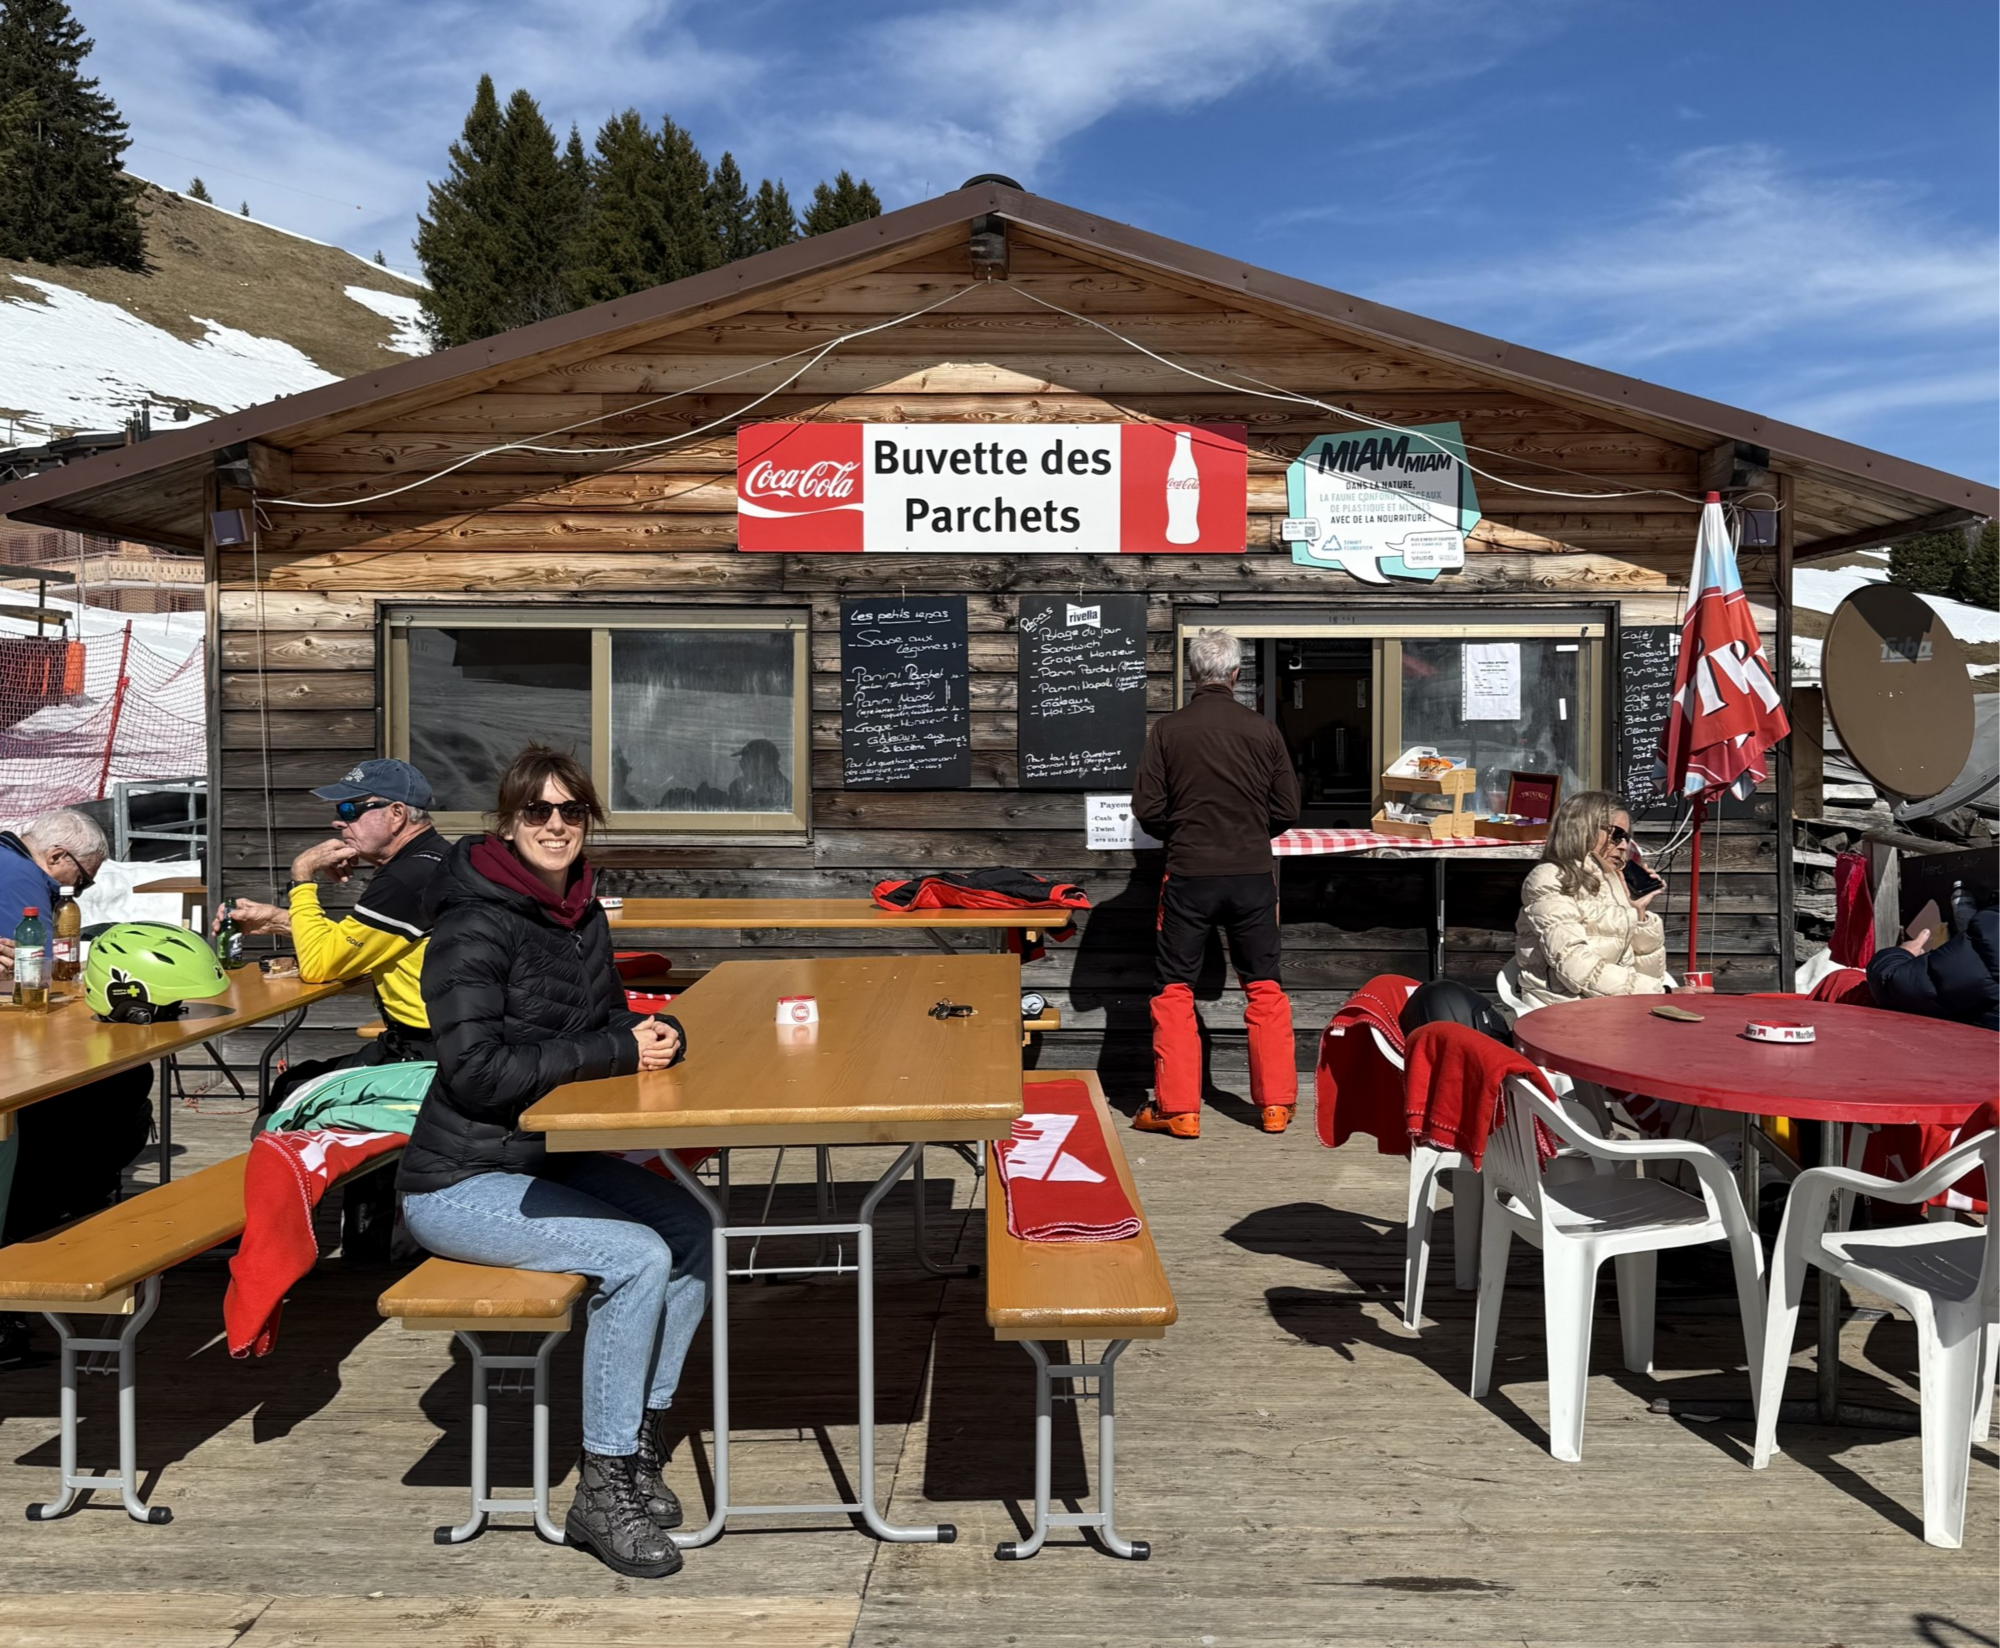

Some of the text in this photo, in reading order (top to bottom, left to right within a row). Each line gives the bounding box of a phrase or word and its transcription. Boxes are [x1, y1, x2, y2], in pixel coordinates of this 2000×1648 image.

[875, 438, 1112, 475] Buvette des
[1318, 435, 1452, 474] MIAM MIAM
[745, 460, 861, 499] Coca-Cola
[1346, 480, 1416, 490] DANS LA NATURE,
[1319, 493, 1329, 502] LA
[1331, 492, 1356, 502] FAUNE
[1358, 491, 1396, 502] CONFOND
[1330, 504, 1340, 513] DE
[1342, 502, 1385, 513] PLASTIQUE
[1387, 502, 1397, 511] ET
[905, 496, 1081, 533] Parchets
[1330, 515, 1351, 524] AVEC
[1353, 515, 1363, 524] DE
[1365, 515, 1375, 523] LA
[1069, 609, 1098, 622] rivella
[1081, 627, 1096, 637] du
[1040, 639, 1101, 654] Sandwich
[1037, 666, 1076, 678] Panini
[1038, 682, 1080, 694] Panini
